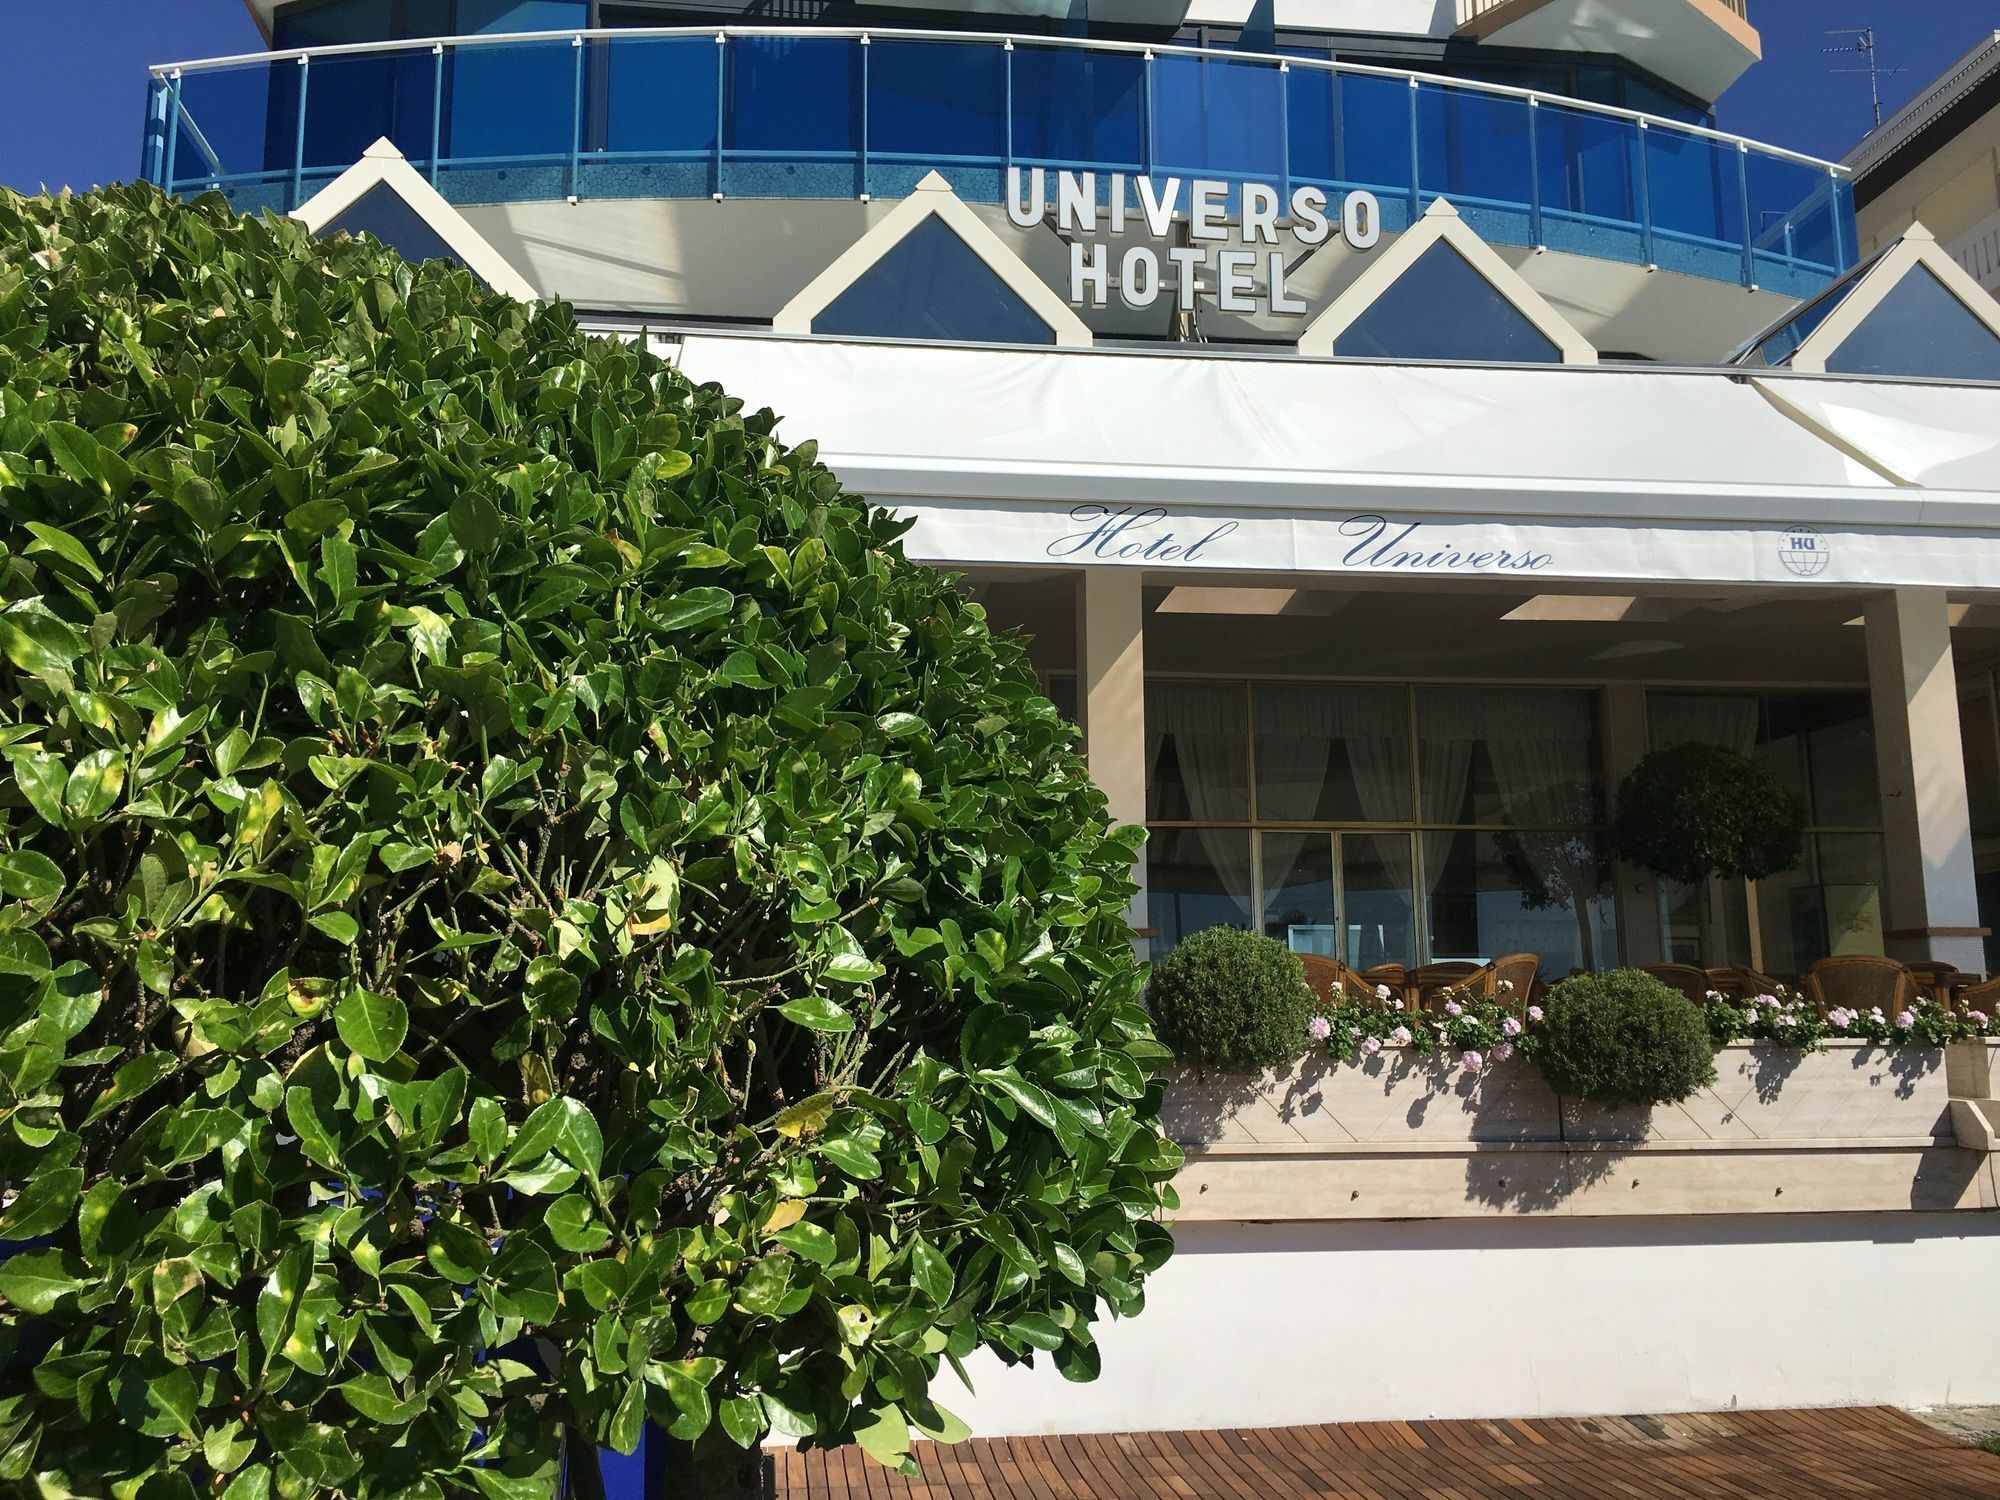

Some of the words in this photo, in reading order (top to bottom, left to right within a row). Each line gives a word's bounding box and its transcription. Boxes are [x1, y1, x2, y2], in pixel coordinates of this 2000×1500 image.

[1007, 166, 1380, 249] UNIVERSO
[1069, 243, 1307, 315] HOTEL
[1046, 504, 1239, 562] Hotel
[1338, 514, 1554, 570] Universo
